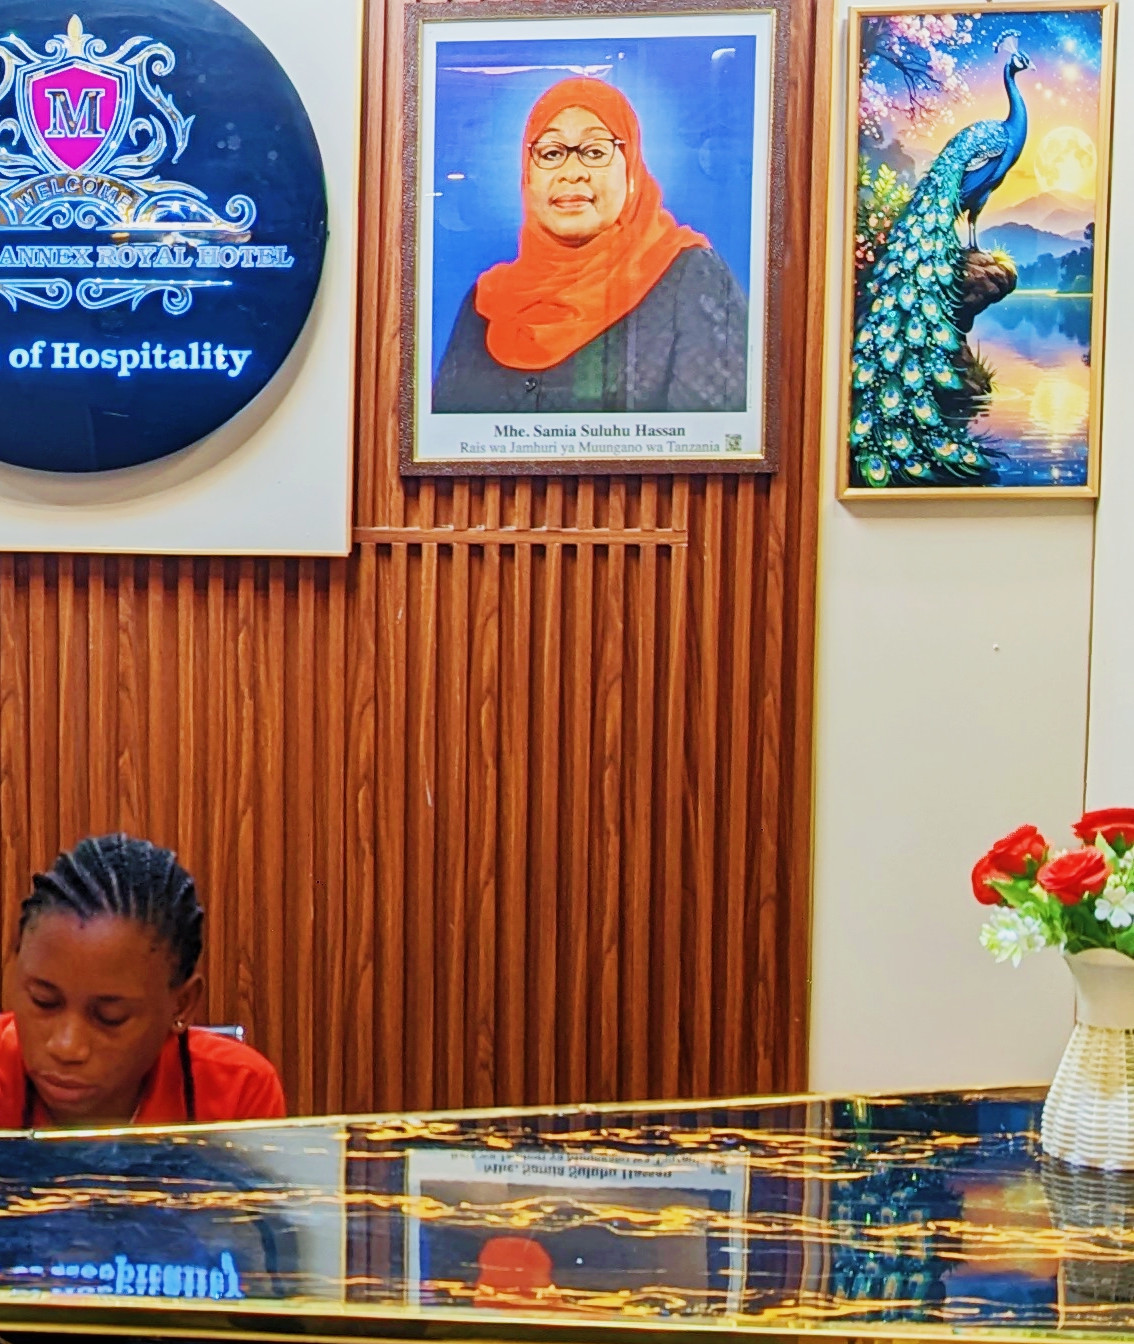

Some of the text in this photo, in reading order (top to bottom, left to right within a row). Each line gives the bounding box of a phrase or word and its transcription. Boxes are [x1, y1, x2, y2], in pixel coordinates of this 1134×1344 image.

[45, 88, 105, 138] M
[14, 175, 134, 211] WELCOME
[96, 245, 193, 268] ROYAL
[195, 245, 295, 268] HOTEL
[8, 340, 47, 369] of
[50, 341, 253, 378] Hospitality
[494, 423, 686, 438] Mhe. Samia Suluhu Hassan
[460, 440, 721, 456] Rais wa Jamhuri ya Muungano wa Tanzania
